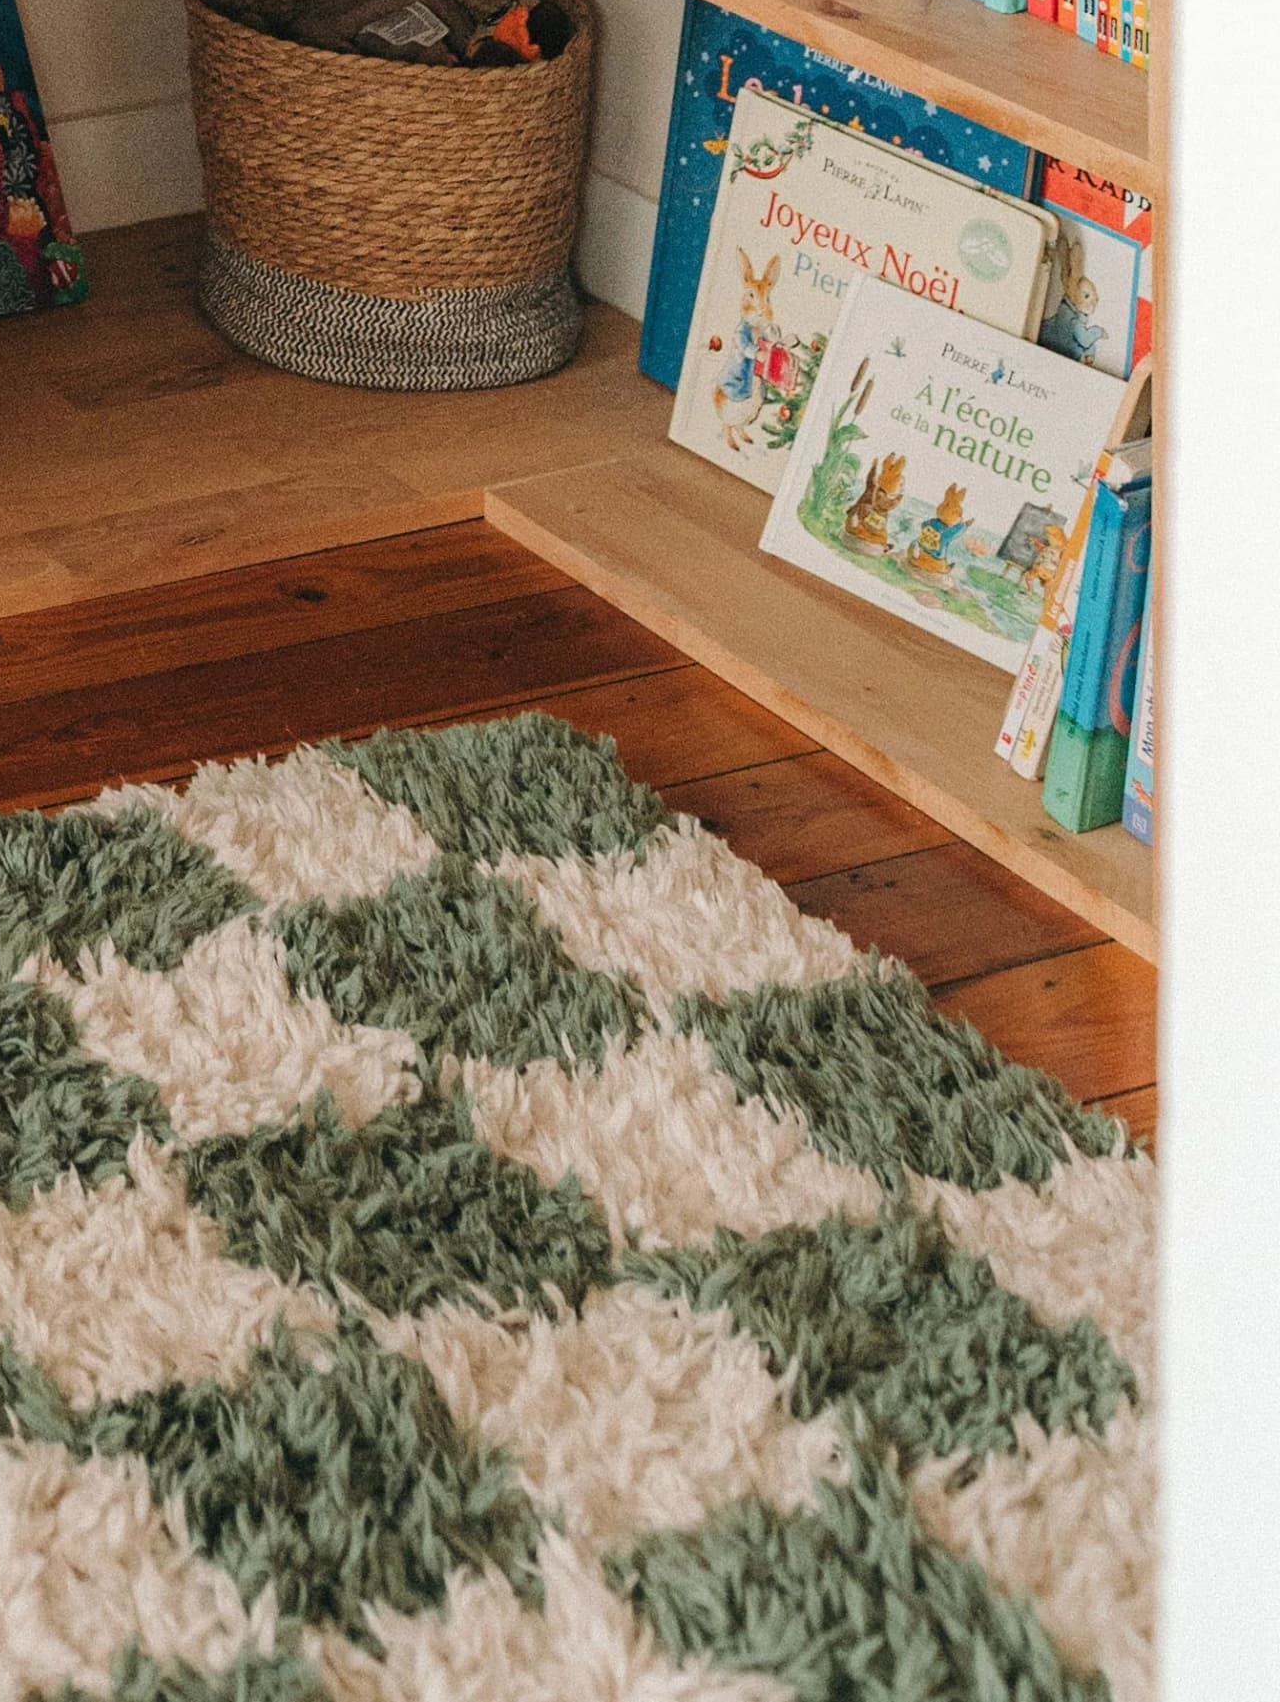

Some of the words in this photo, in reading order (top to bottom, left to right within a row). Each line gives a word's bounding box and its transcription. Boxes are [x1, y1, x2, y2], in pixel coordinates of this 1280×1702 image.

[804, 45, 848, 74] PIERRE
[863, 70, 904, 99] LAPIN
[823, 157, 867, 190] PIERRE
[883, 184, 924, 216] LAPIN
[760, 190, 873, 269] Joyeux
[793, 251, 848, 298] Pier
[941, 342, 988, 375] PIERRE
[1007, 370, 1050, 401] LAPIN
[915, 375, 933, 406] À
[940, 387, 1034, 448] l'école
[891, 405, 912, 426] de
[914, 414, 930, 434] la
[932, 424, 1052, 494] nature
